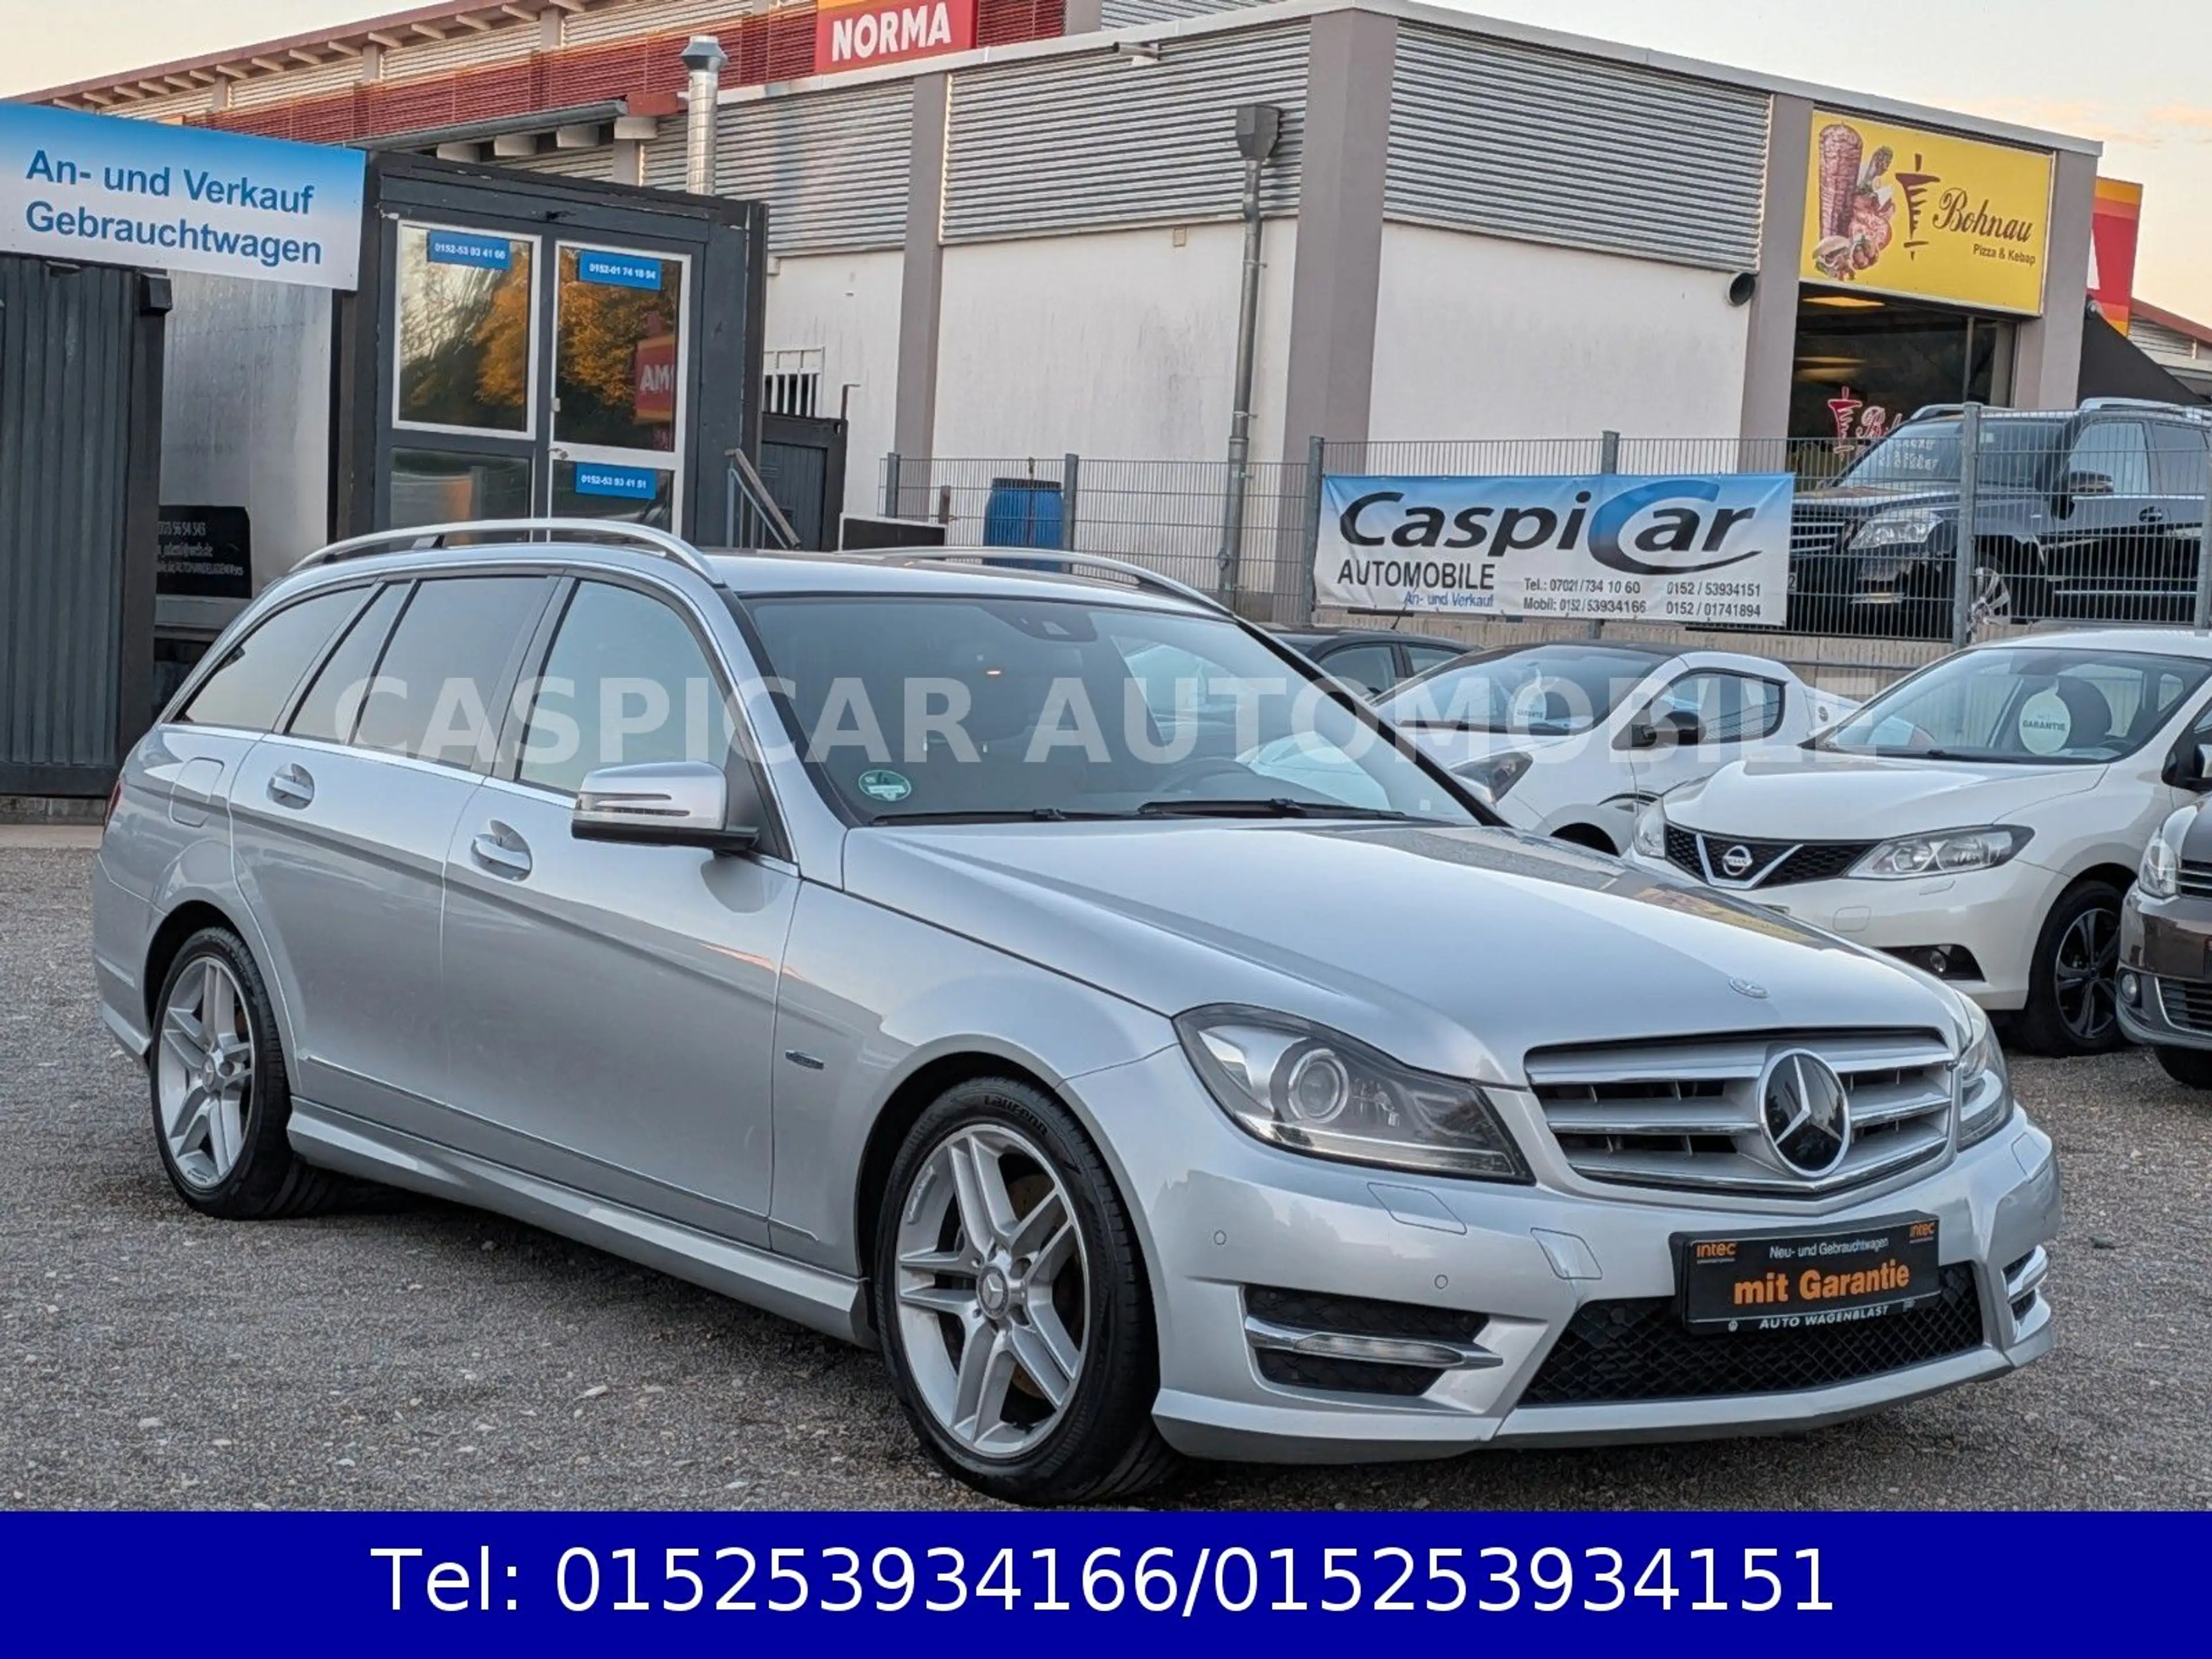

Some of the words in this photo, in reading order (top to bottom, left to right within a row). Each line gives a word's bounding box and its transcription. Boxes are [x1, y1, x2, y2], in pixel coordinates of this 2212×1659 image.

[832, 2, 952, 62] NORMA
[26, 149, 91, 185] An-
[104, 166, 171, 196] und
[183, 169, 315, 214] Verkauf
[1933, 188, 2034, 243] Bohnau
[26, 200, 321, 267] Gebrauchtwagen
[482, 249, 493, 259] 41
[1973, 244, 1997, 259] Pizza
[1998, 248, 2006, 260] &
[2008, 250, 2036, 266] Kebap
[1340, 479, 1762, 575] CaspiCar
[1338, 559, 1495, 590] AUTOMOBILE
[1524, 578, 1547, 591] Tel.:
[1609, 581, 1621, 593] 10
[1624, 581, 1641, 594] 60
[1667, 581, 1695, 595] 0152
[1705, 582, 1761, 597] 53934151
[1404, 591, 1423, 605] An-
[1427, 592, 1448, 606] und
[1452, 593, 1494, 607] Verkauf
[1524, 597, 1556, 611] Mobil:
[1666, 601, 1694, 615] 0152
[1703, 603, 1761, 618] 01741894
[1696, 1242, 1736, 1257] intec
[1770, 1245, 1796, 1259] Neu-
[1798, 1241, 1817, 1257] und
[1819, 1237, 1889, 1256] Gebrauchtwagen
[1734, 1272, 1789, 1306] mit
[1799, 1258, 1911, 1300] Garantie
[1759, 1317, 1801, 1331] AUTO
[1804, 1304, 1890, 1325] WAGENBLAST
